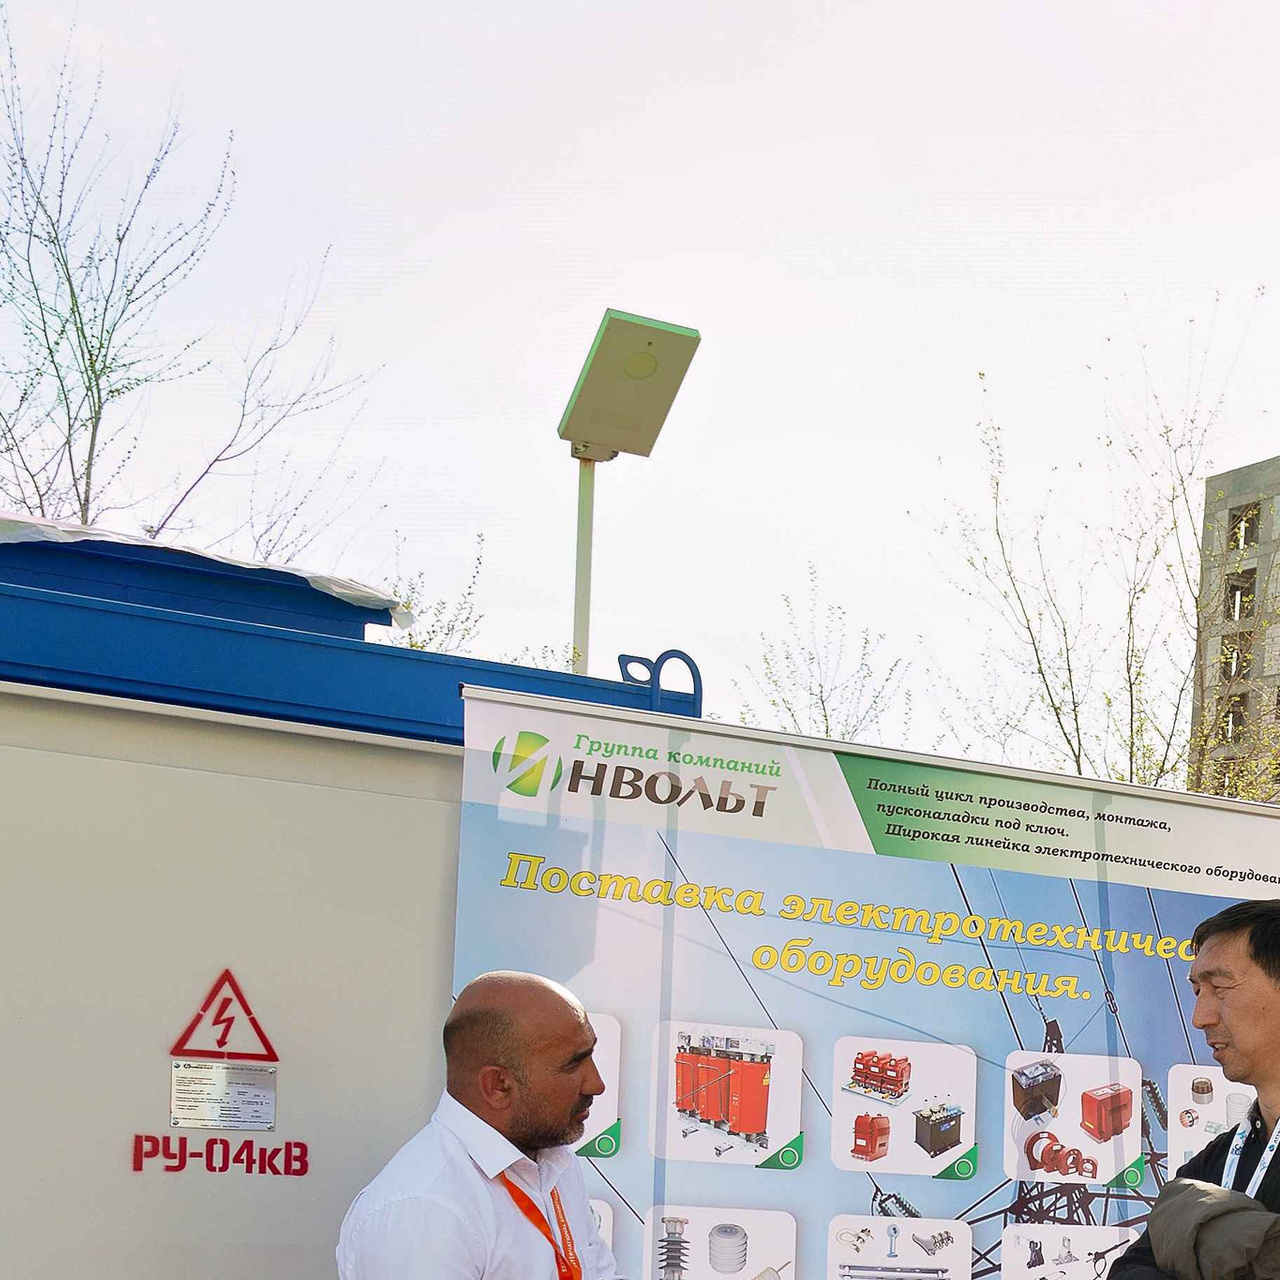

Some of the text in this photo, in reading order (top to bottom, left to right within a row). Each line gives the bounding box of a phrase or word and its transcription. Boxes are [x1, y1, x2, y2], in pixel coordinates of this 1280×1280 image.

[573, 734, 782, 777] Группа компаний
[866, 777, 1172, 833] Полный цикл производства, монтажа,
[876, 802, 1070, 838] пусконаладки под ключ.
[884, 823, 961, 844] Широкая
[964, 836, 1031, 853] линейка
[1034, 844, 1201, 875] электротехнического
[500, 851, 1196, 962] Поставка электротехничес
[752, 937, 1092, 1000] оборудования.
